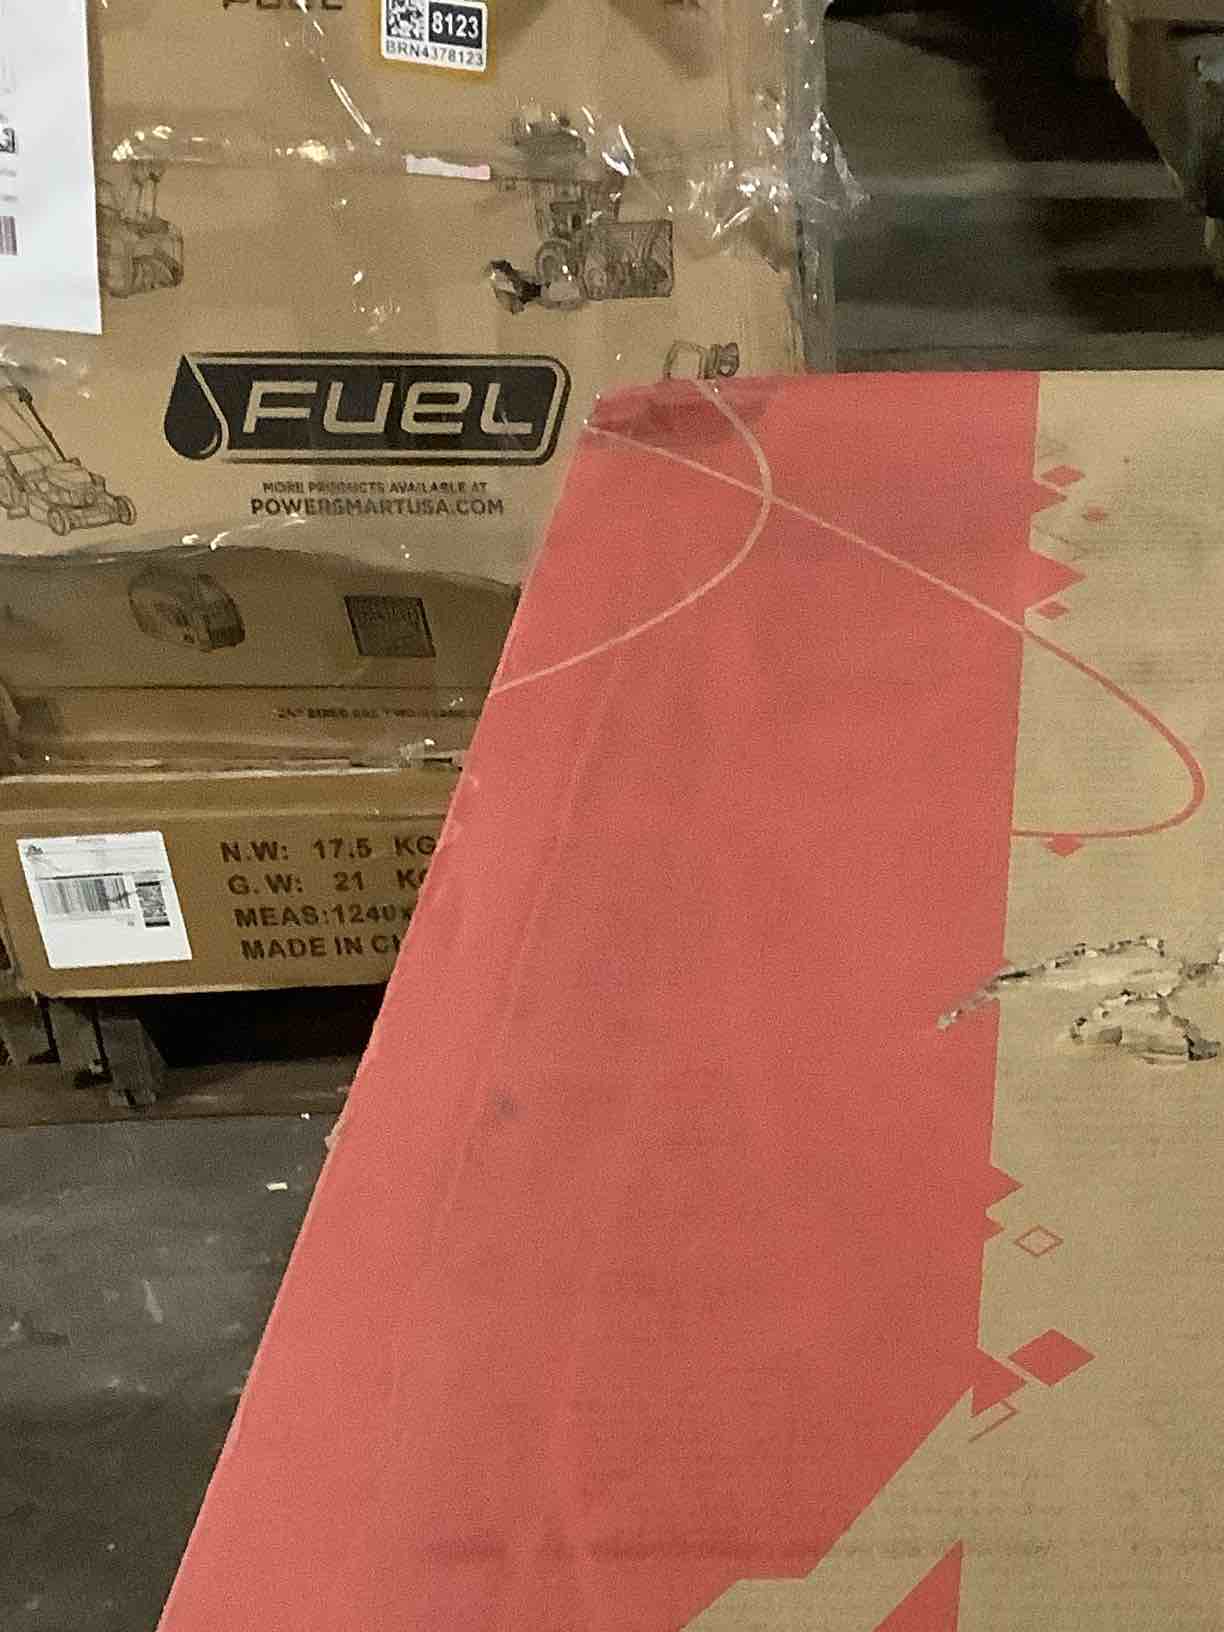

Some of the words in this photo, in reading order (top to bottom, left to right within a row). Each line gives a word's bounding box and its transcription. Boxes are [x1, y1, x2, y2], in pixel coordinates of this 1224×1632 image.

[431, 11, 479, 38] 8123
[386, 39, 483, 66] BRN4378123
[313, 837, 372, 859] 17.5
[333, 871, 364, 891] 21
[241, 936, 327, 960] MADE
[335, 936, 363, 956] IN
